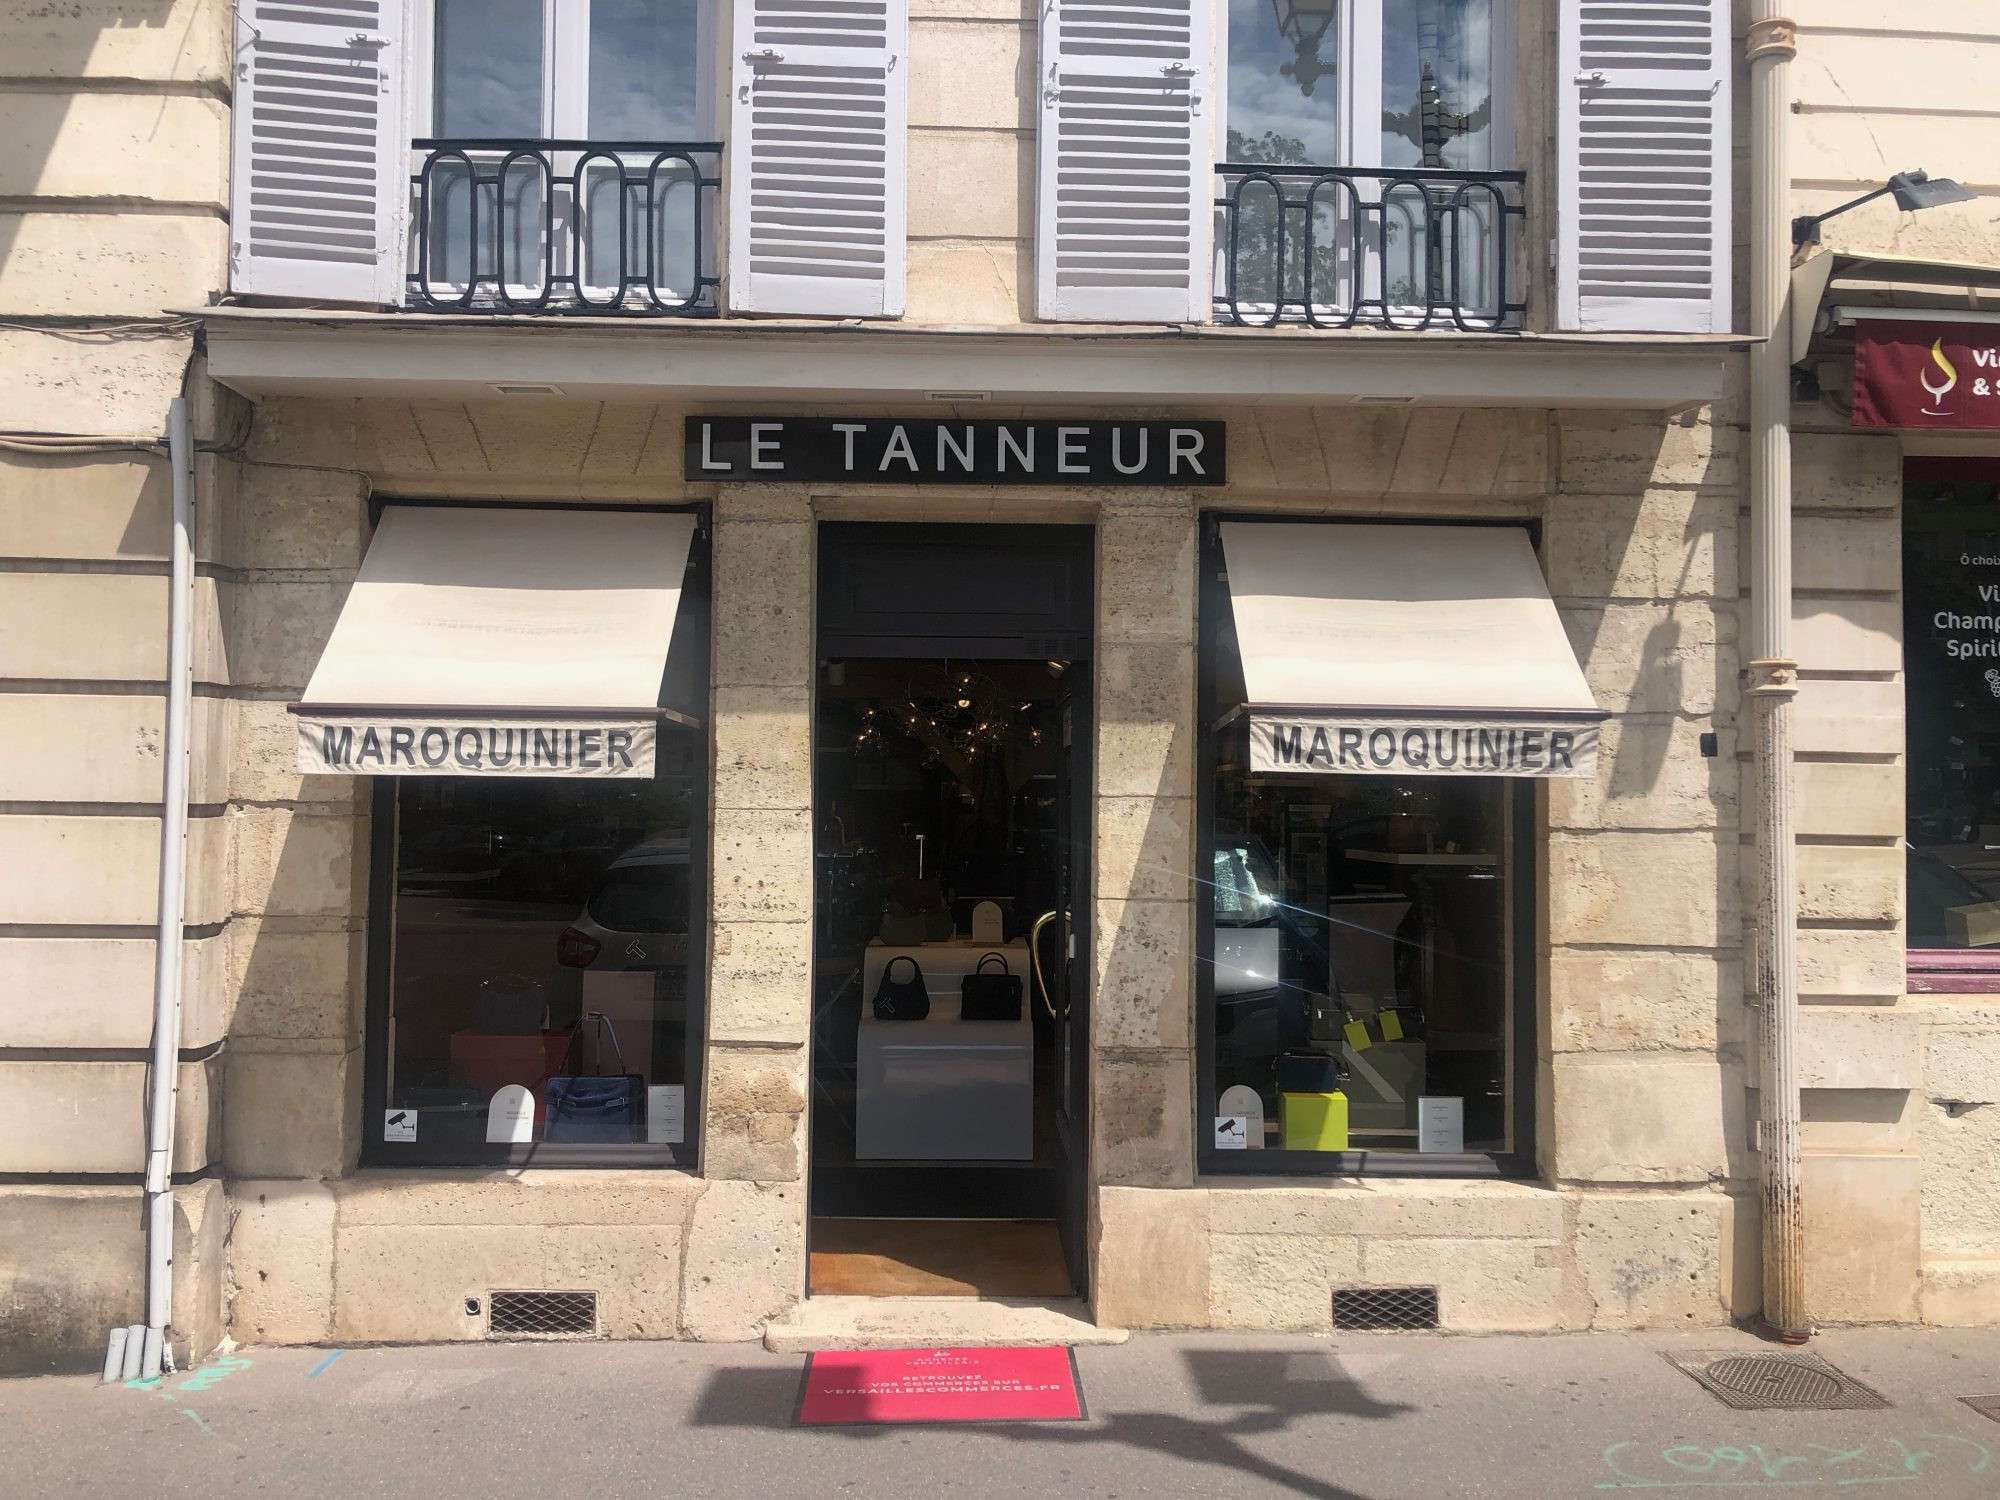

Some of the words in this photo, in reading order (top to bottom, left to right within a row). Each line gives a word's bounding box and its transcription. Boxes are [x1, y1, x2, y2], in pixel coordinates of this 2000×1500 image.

[1972, 378, 1991, 396] &
[701, 423, 785, 470] LE
[832, 424, 1206, 475] TANNEUR
[323, 726, 634, 769] MAROQUINIER
[1273, 726, 1575, 769] MAROQUINIER
